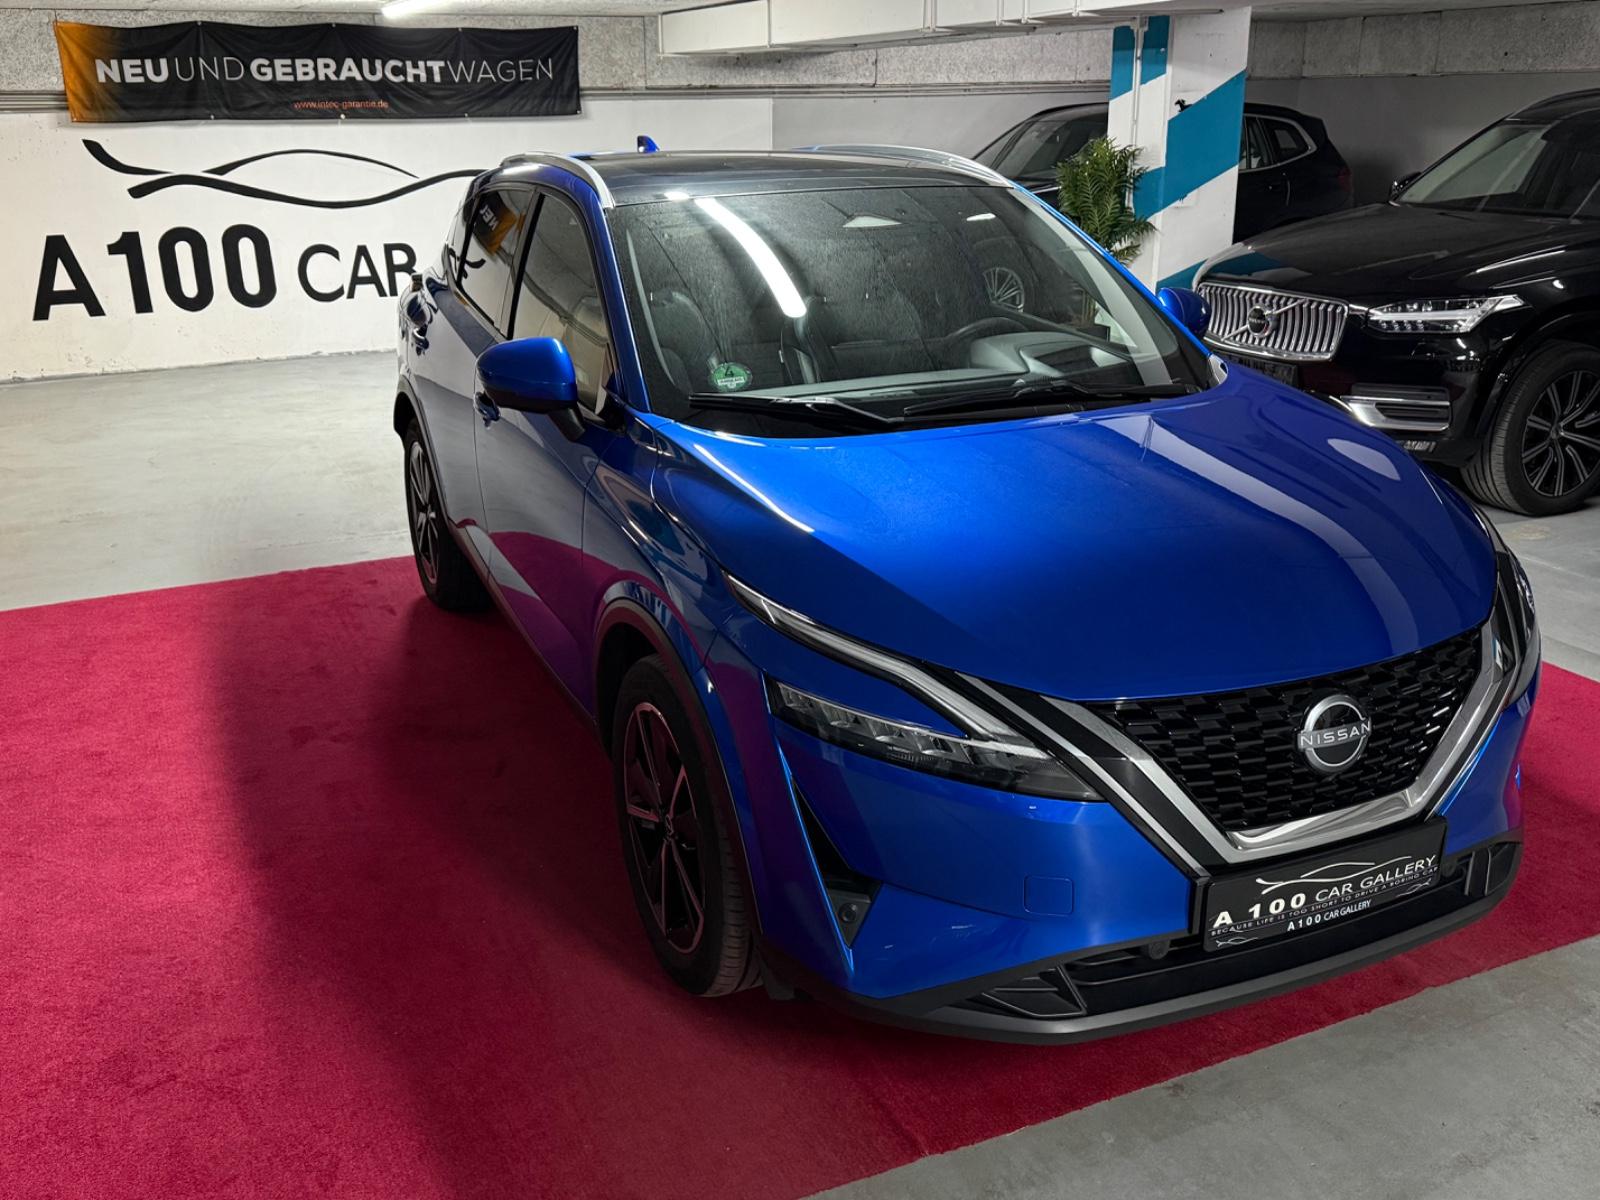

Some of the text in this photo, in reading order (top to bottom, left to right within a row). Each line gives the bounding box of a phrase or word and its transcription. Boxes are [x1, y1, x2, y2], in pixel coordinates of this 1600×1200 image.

[292, 99, 390, 110] www.intec-garantie.de
[32, 223, 418, 322] A 100 CAR
[1300, 721, 1371, 747] NISSAN
[1211, 922, 1252, 936] BECAUSE
[1255, 916, 1275, 927] LIFE
[1288, 907, 1309, 918] TOO
[1310, 900, 1338, 912] SHORT
[1341, 894, 1352, 903] TO
[1355, 885, 1379, 899] DRIVE
[1212, 910, 1234, 929] A
[1315, 883, 1353, 902] CAR
[1359, 854, 1437, 890] GALLERY
[1287, 921, 1296, 932] A
[1323, 909, 1340, 922] CAR
[1339, 899, 1372, 918] GALLERY
